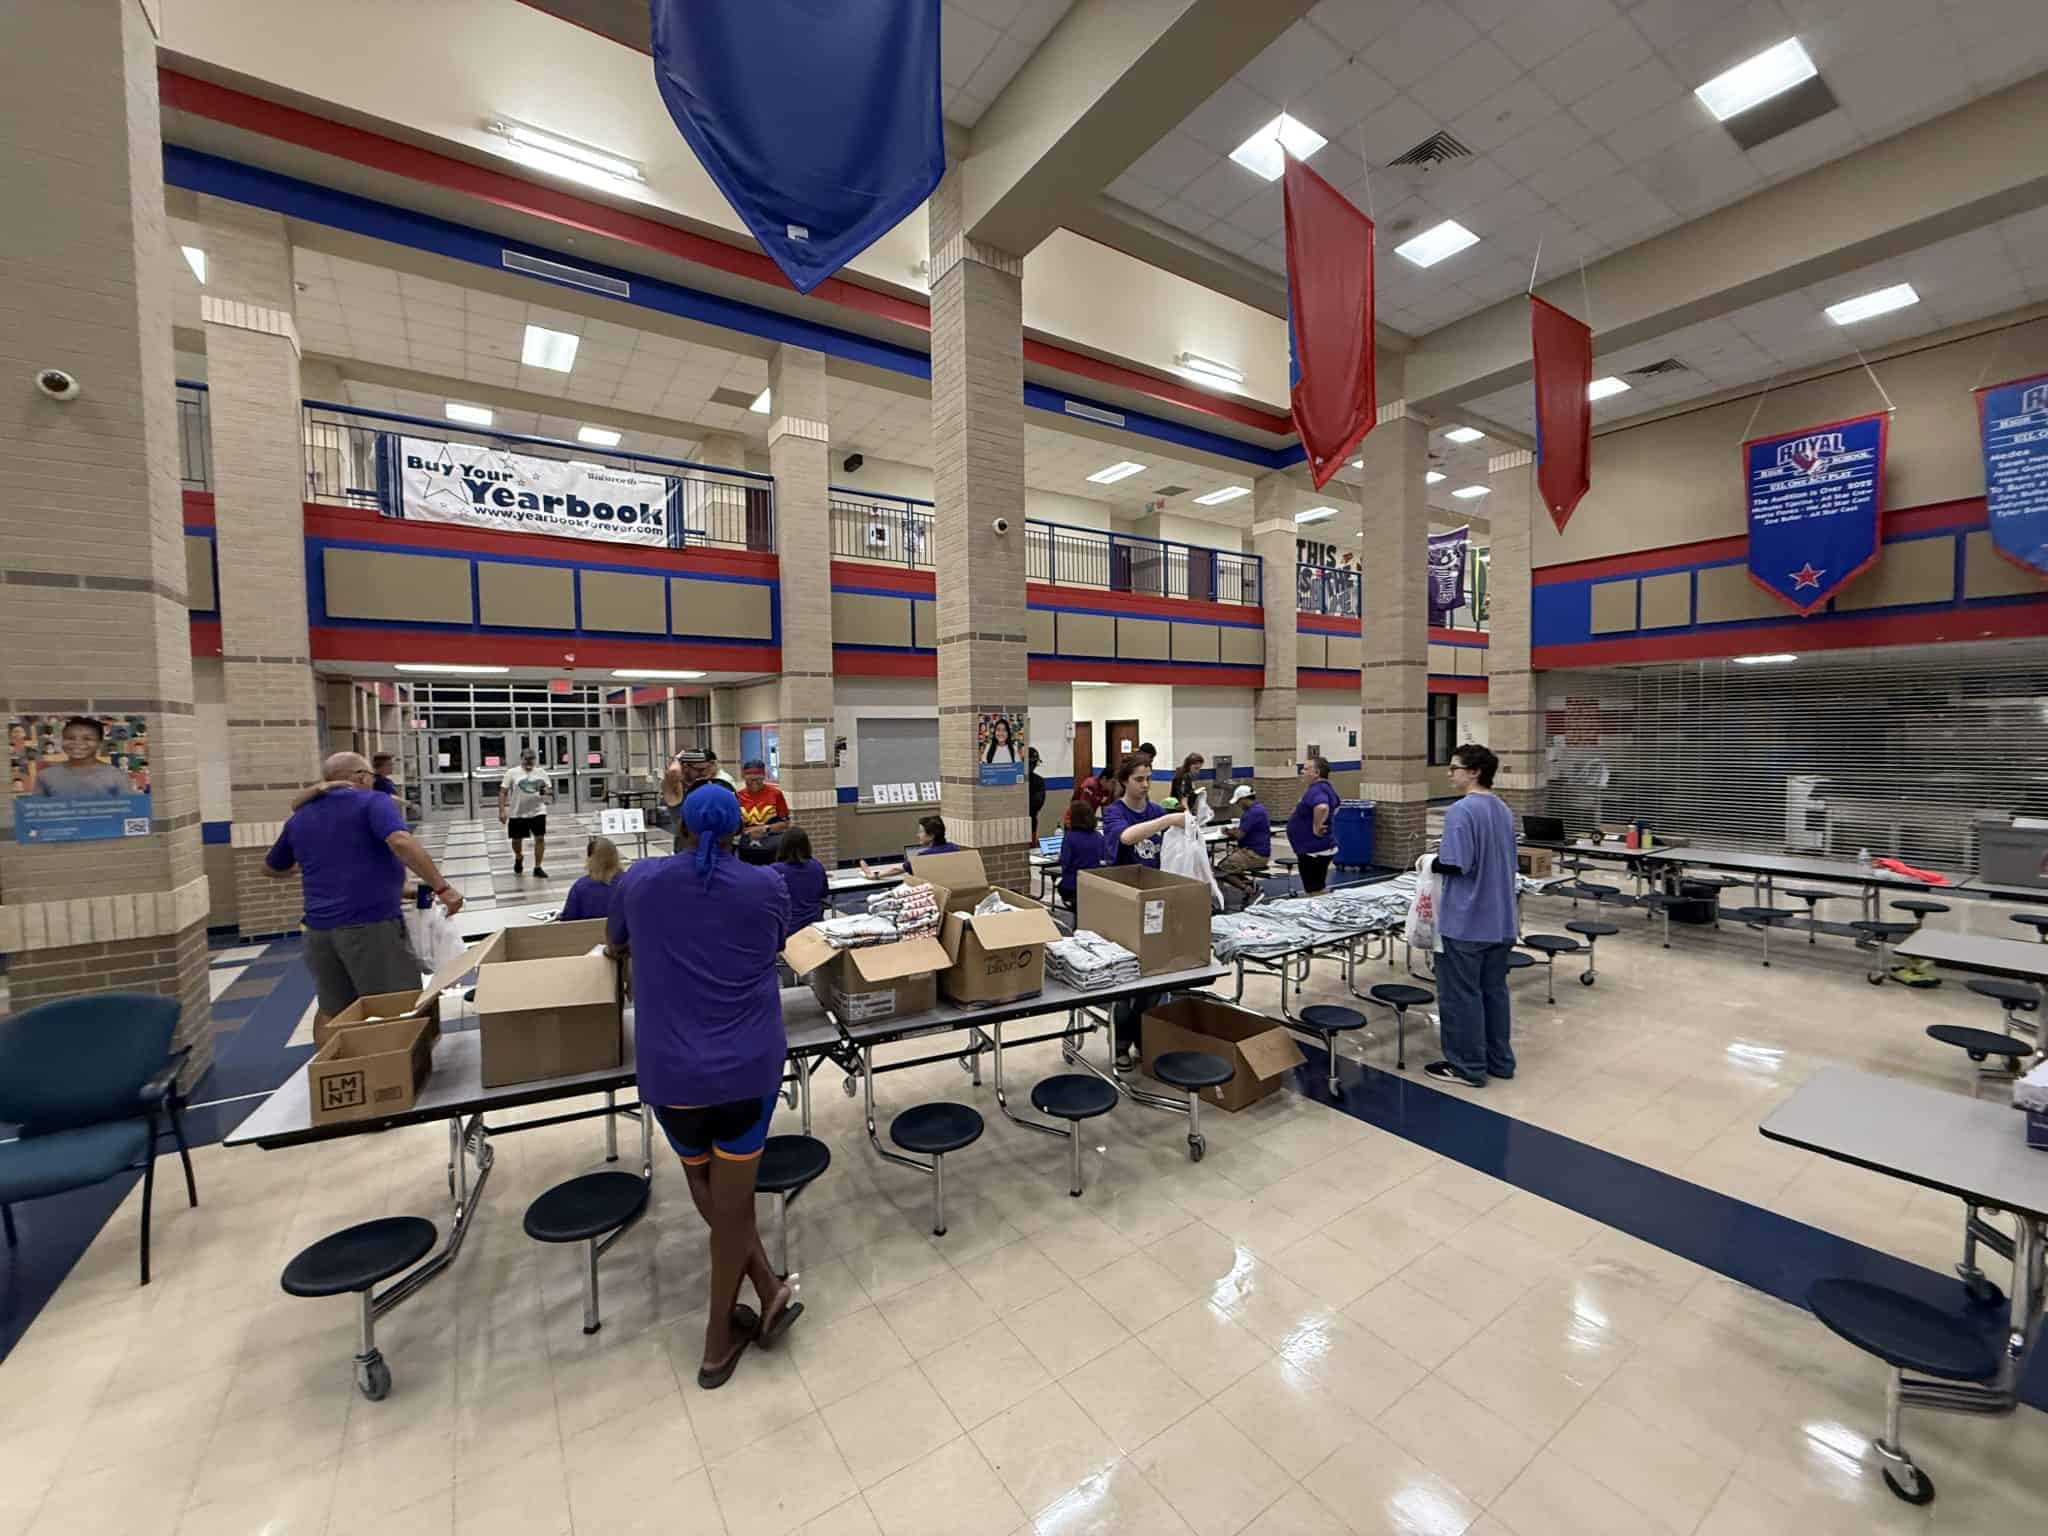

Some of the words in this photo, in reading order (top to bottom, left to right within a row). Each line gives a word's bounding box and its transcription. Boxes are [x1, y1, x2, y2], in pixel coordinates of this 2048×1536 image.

[1777, 433, 1845, 465] ROYAL
[407, 455, 454, 476] Buy
[460, 464, 513, 482] Your
[462, 478, 664, 526] Yearbook
[474, 506, 664, 536] www.yearbookforever.com
[1296, 538, 1337, 569] THIS
